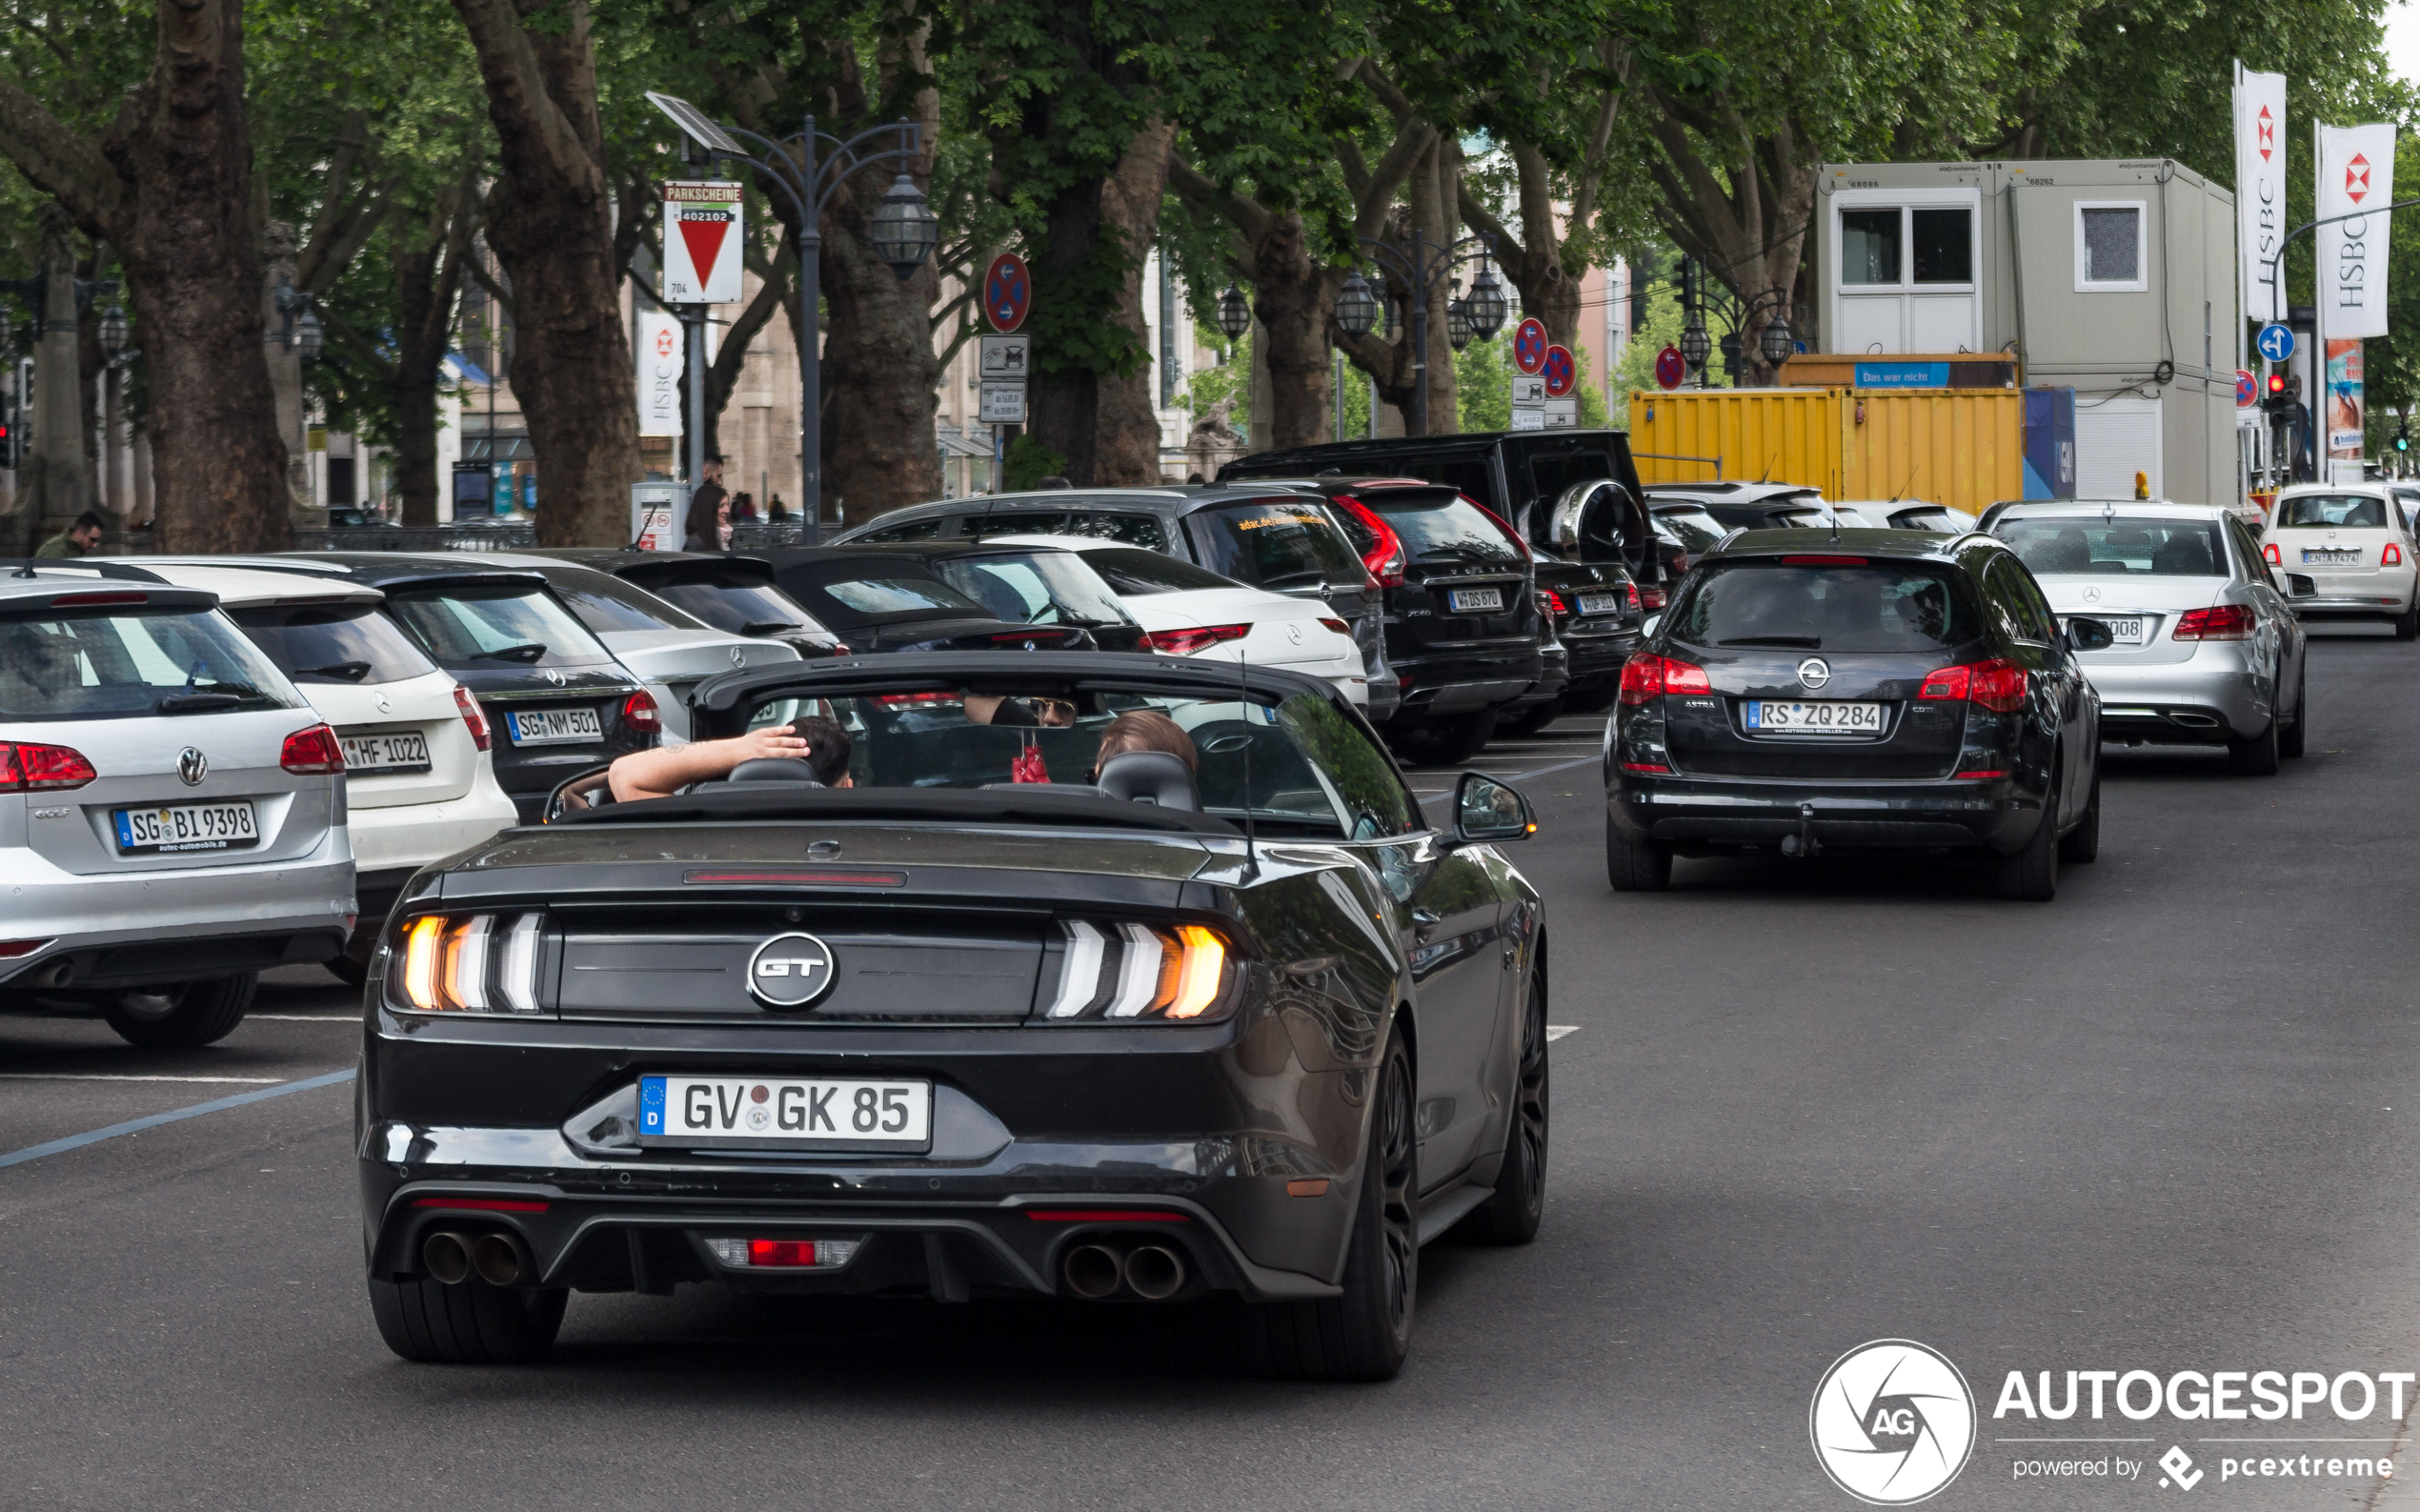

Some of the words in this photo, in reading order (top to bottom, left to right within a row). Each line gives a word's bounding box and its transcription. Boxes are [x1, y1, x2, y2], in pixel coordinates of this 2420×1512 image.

[668, 188, 741, 202] PARKSCHEINE
[682, 212, 728, 222] 402102
[2258, 177, 2276, 286] HSBC
[2339, 215, 2368, 310] HSBC
[671, 283, 687, 294] 704
[1863, 373, 1882, 383] Das
[1883, 374, 1901, 383] war
[1904, 373, 1928, 383] nicht
[653, 365, 673, 419] HSBC
[2309, 554, 2322, 563] EN
[2327, 554, 2333, 563] A
[2334, 554, 2357, 563] 7474
[1458, 592, 1465, 607] W
[1470, 592, 1482, 607] DS
[1482, 591, 1498, 606] 870
[518, 714, 541, 736] SG
[547, 713, 570, 736] NM
[569, 711, 600, 734] 501
[1762, 704, 1788, 724] RS
[1805, 705, 1833, 726] ZQ
[1837, 706, 1876, 727] 284
[358, 739, 381, 765] HF
[383, 736, 427, 763] 1022
[34, 808, 71, 819] GOLF
[133, 813, 160, 841] SG
[174, 810, 201, 838] BI
[203, 807, 252, 837] 9398
[158, 840, 228, 852] autec-automobile.de
[757, 958, 825, 978] GT
[647, 1112, 658, 1126] D
[684, 1084, 745, 1130] GV
[777, 1085, 838, 1132] GK
[852, 1087, 910, 1133] 85
